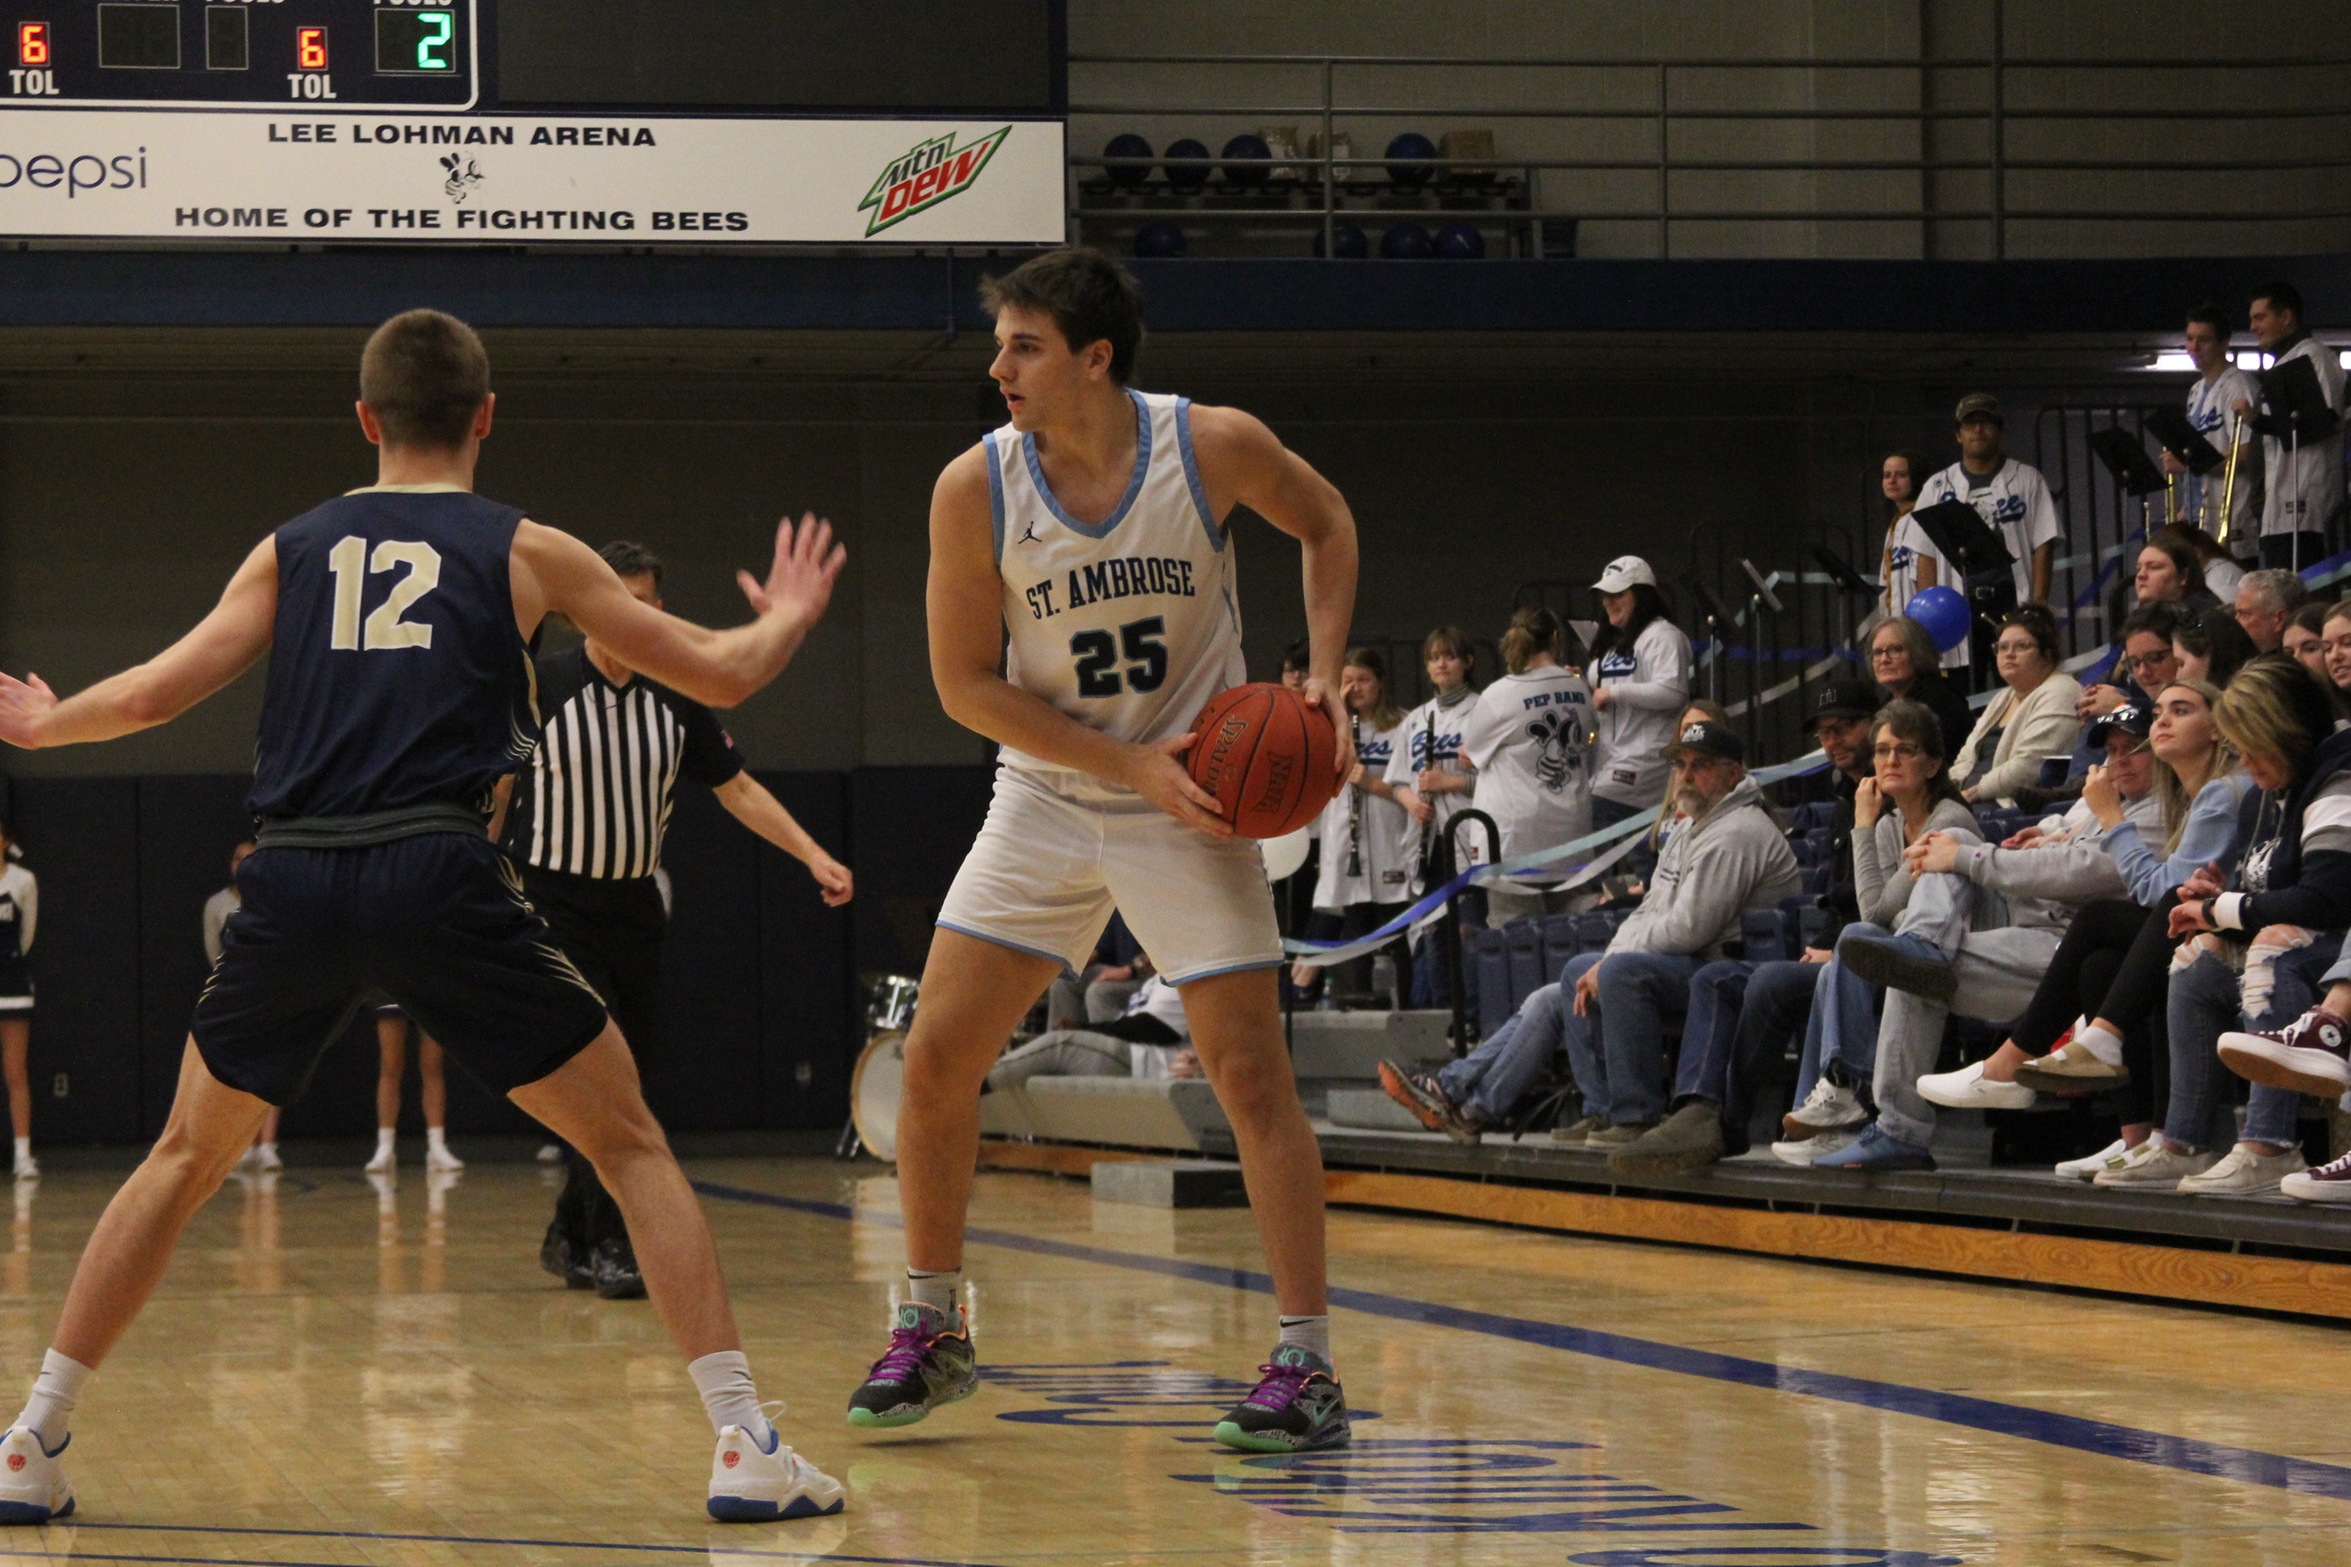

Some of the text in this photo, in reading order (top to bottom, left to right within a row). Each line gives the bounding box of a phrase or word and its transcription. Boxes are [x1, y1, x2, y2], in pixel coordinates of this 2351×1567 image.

[21, 25, 47, 64] 6
[300, 30, 326, 68] 6
[417, 12, 452, 69] 2
[9, 69, 59, 96] TOL
[287, 74, 337, 99] TOL
[268, 123, 656, 147] LEE LOHMAN ARENA
[175, 207, 749, 232] HOME OF THE FIGHTING BEES
[328, 535, 442, 651] 12
[1026, 556, 1195, 620] ST. AMBROSE
[1068, 615, 1168, 698] 25
[1523, 694, 1551, 711] PEP
[1203, 714, 1247, 797] SPALDI
[1412, 730, 1463, 758] Bes
